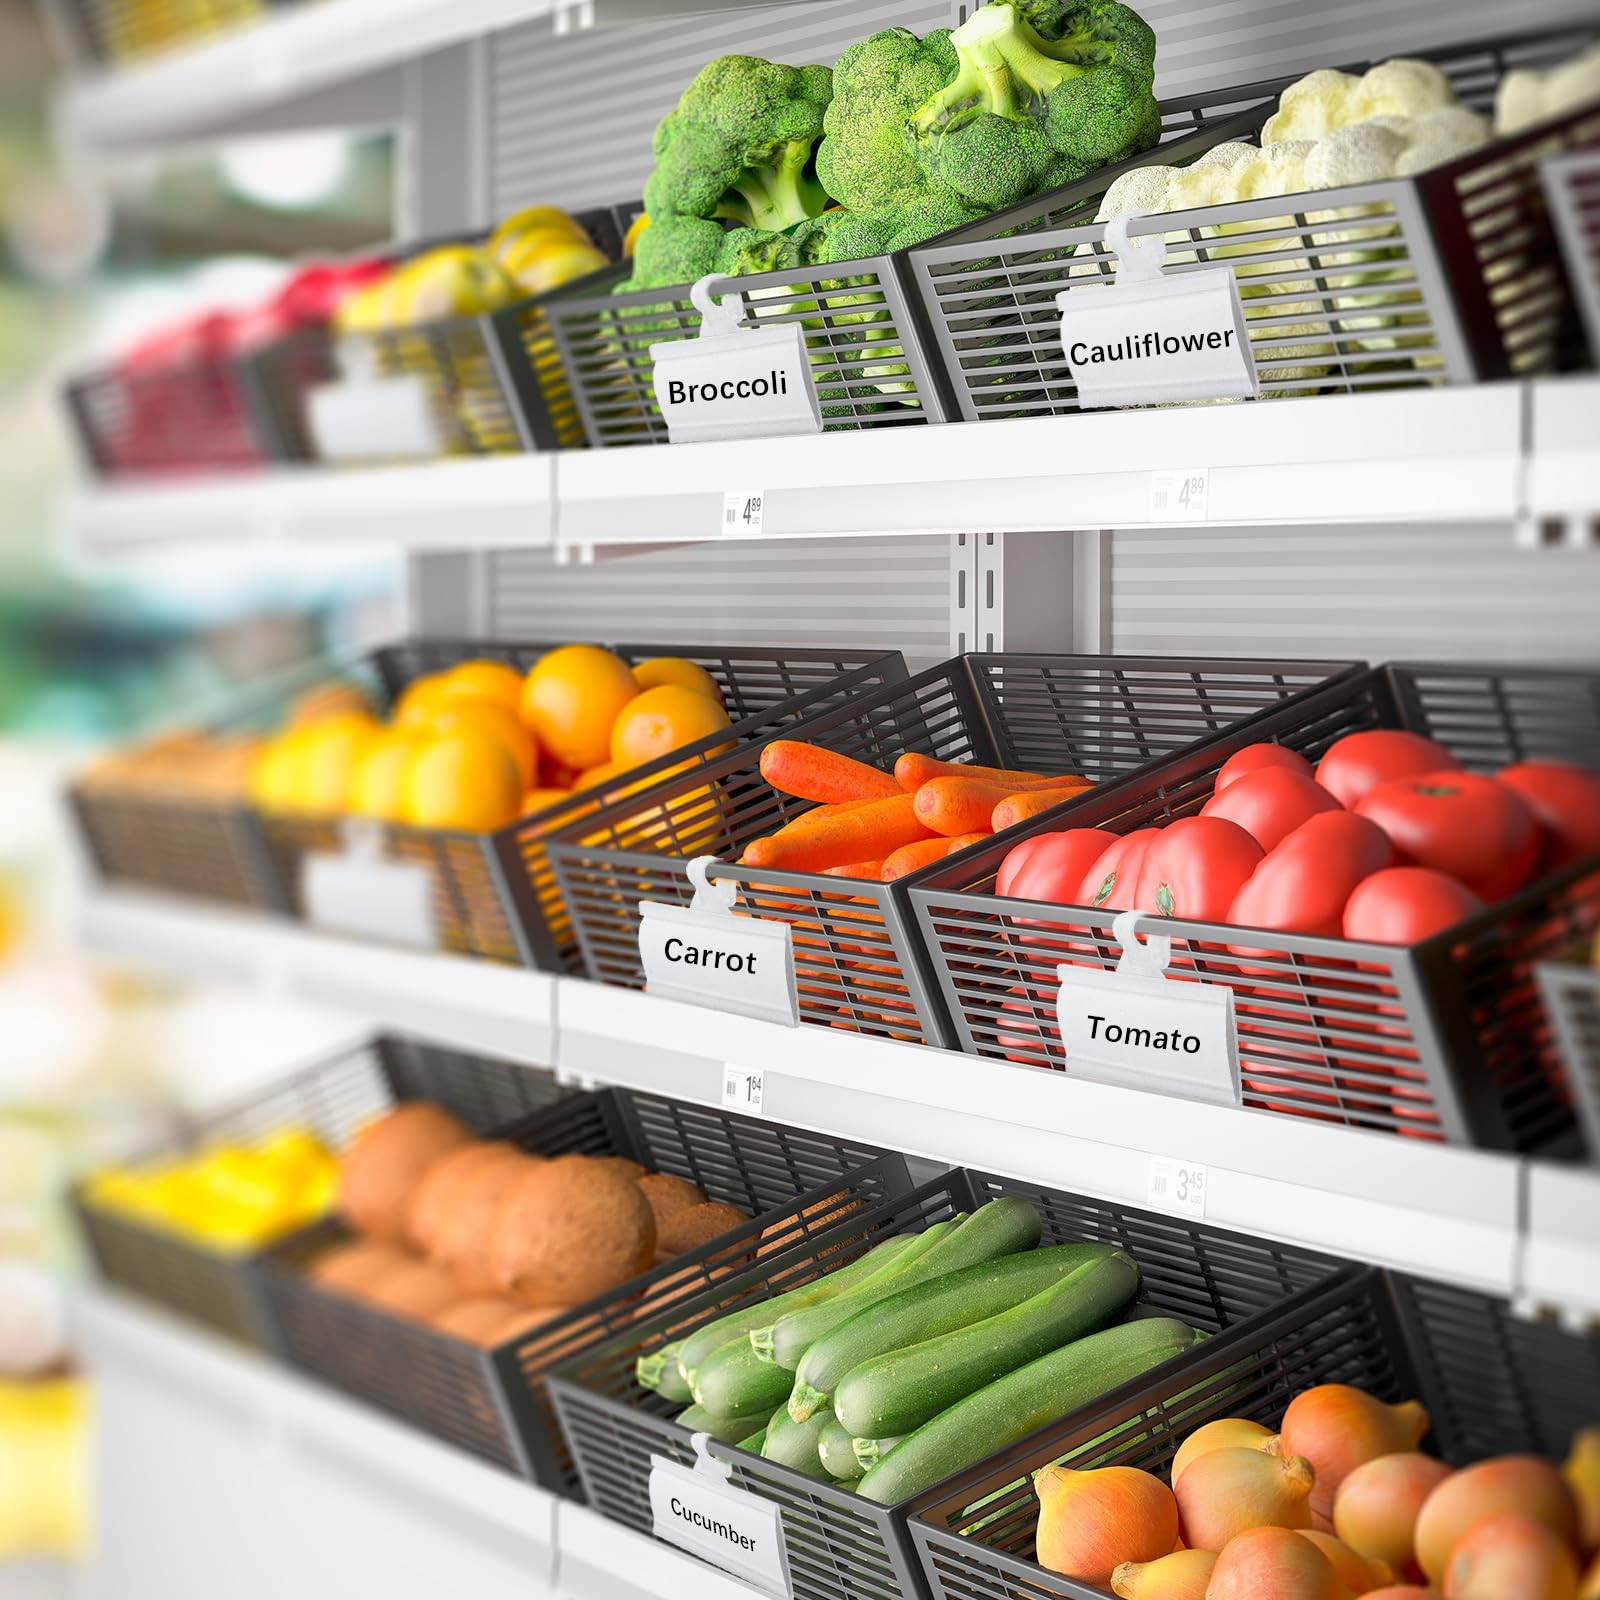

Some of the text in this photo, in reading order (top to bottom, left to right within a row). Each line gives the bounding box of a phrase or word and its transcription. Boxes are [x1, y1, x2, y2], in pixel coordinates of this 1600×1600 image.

[1070, 330, 1234, 366] Cauliflower
[668, 370, 787, 405] Broccoli
[664, 938, 757, 975] Carrot
[1087, 1015, 1201, 1054] Tomato
[670, 1497, 756, 1553] Cucumber
